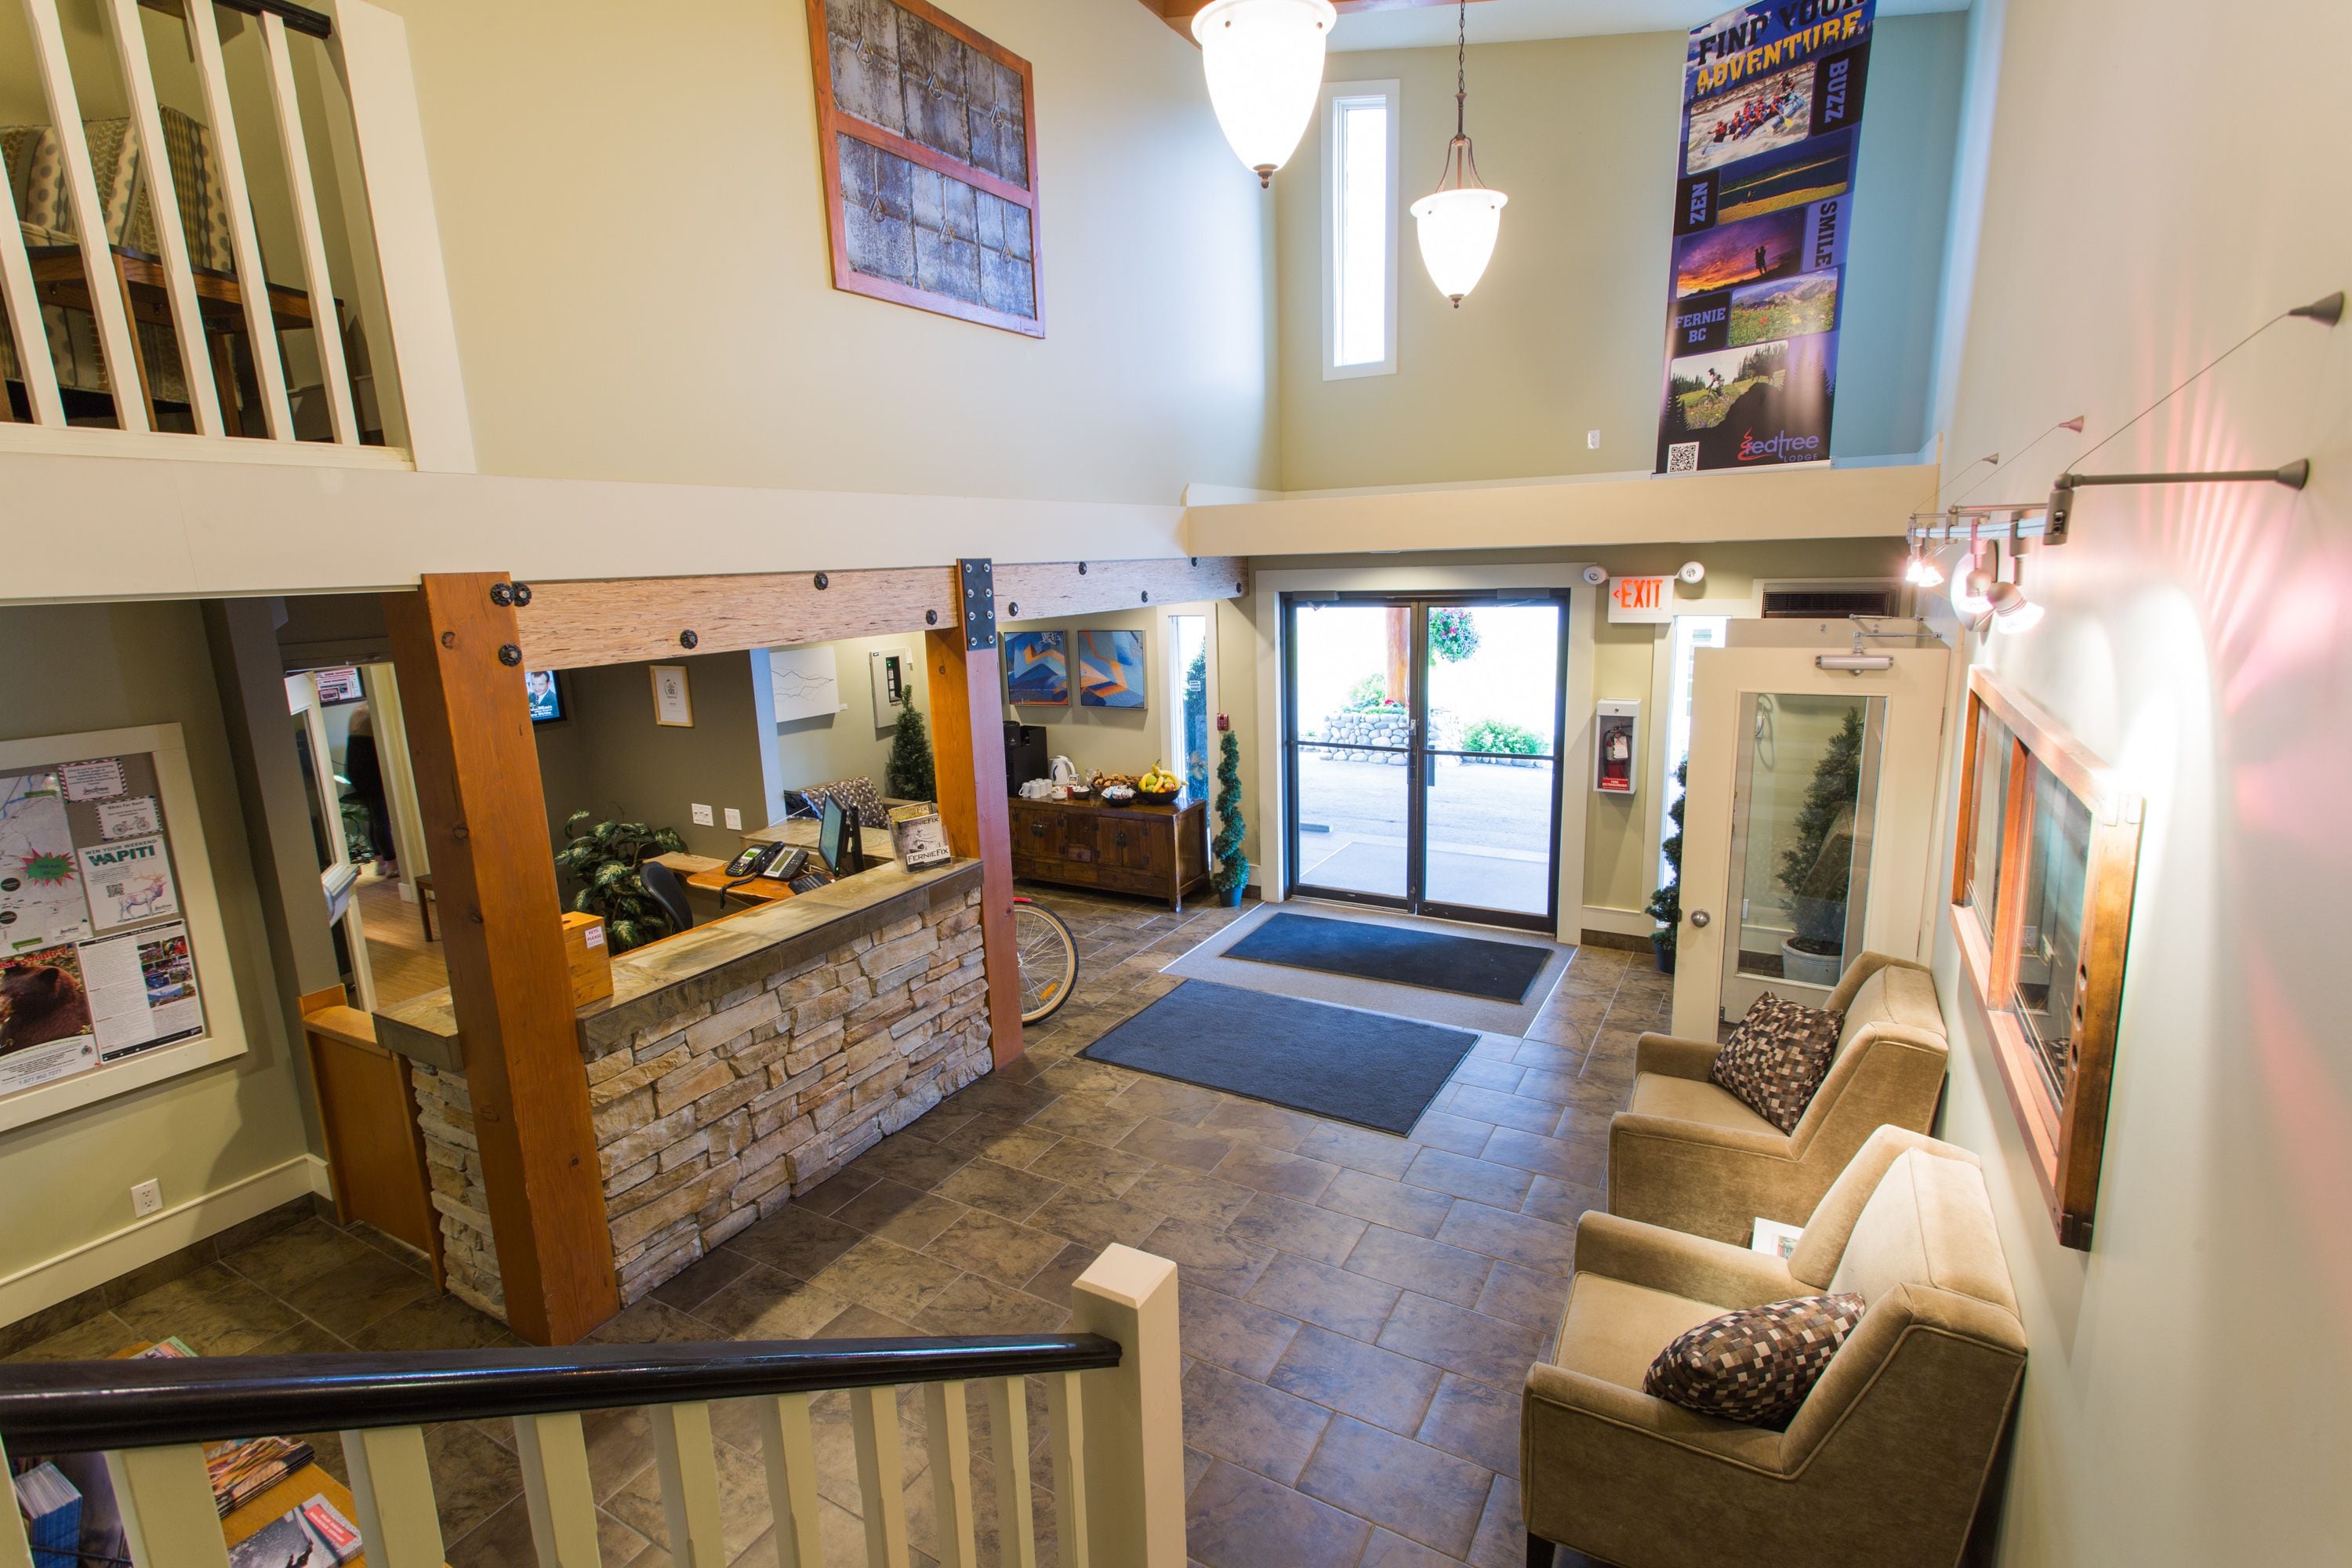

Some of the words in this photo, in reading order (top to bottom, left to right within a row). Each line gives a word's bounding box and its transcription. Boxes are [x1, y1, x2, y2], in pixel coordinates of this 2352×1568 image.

[1697, 9, 1863, 93] ADVENTURE
[1698, 15, 1770, 66] FIND
[1824, 57, 1849, 124] BUZZ
[1690, 181, 1708, 224] ZEN
[1815, 201, 1838, 267] SMILE
[1674, 307, 1726, 329] FERNIE
[1688, 328, 1707, 343] BC
[1784, 453, 1819, 463] LODGE
[1621, 579, 1664, 608] EXIT
[89, 845, 155, 866] WAPITI
[124, 839, 157, 848] WEEKEND
